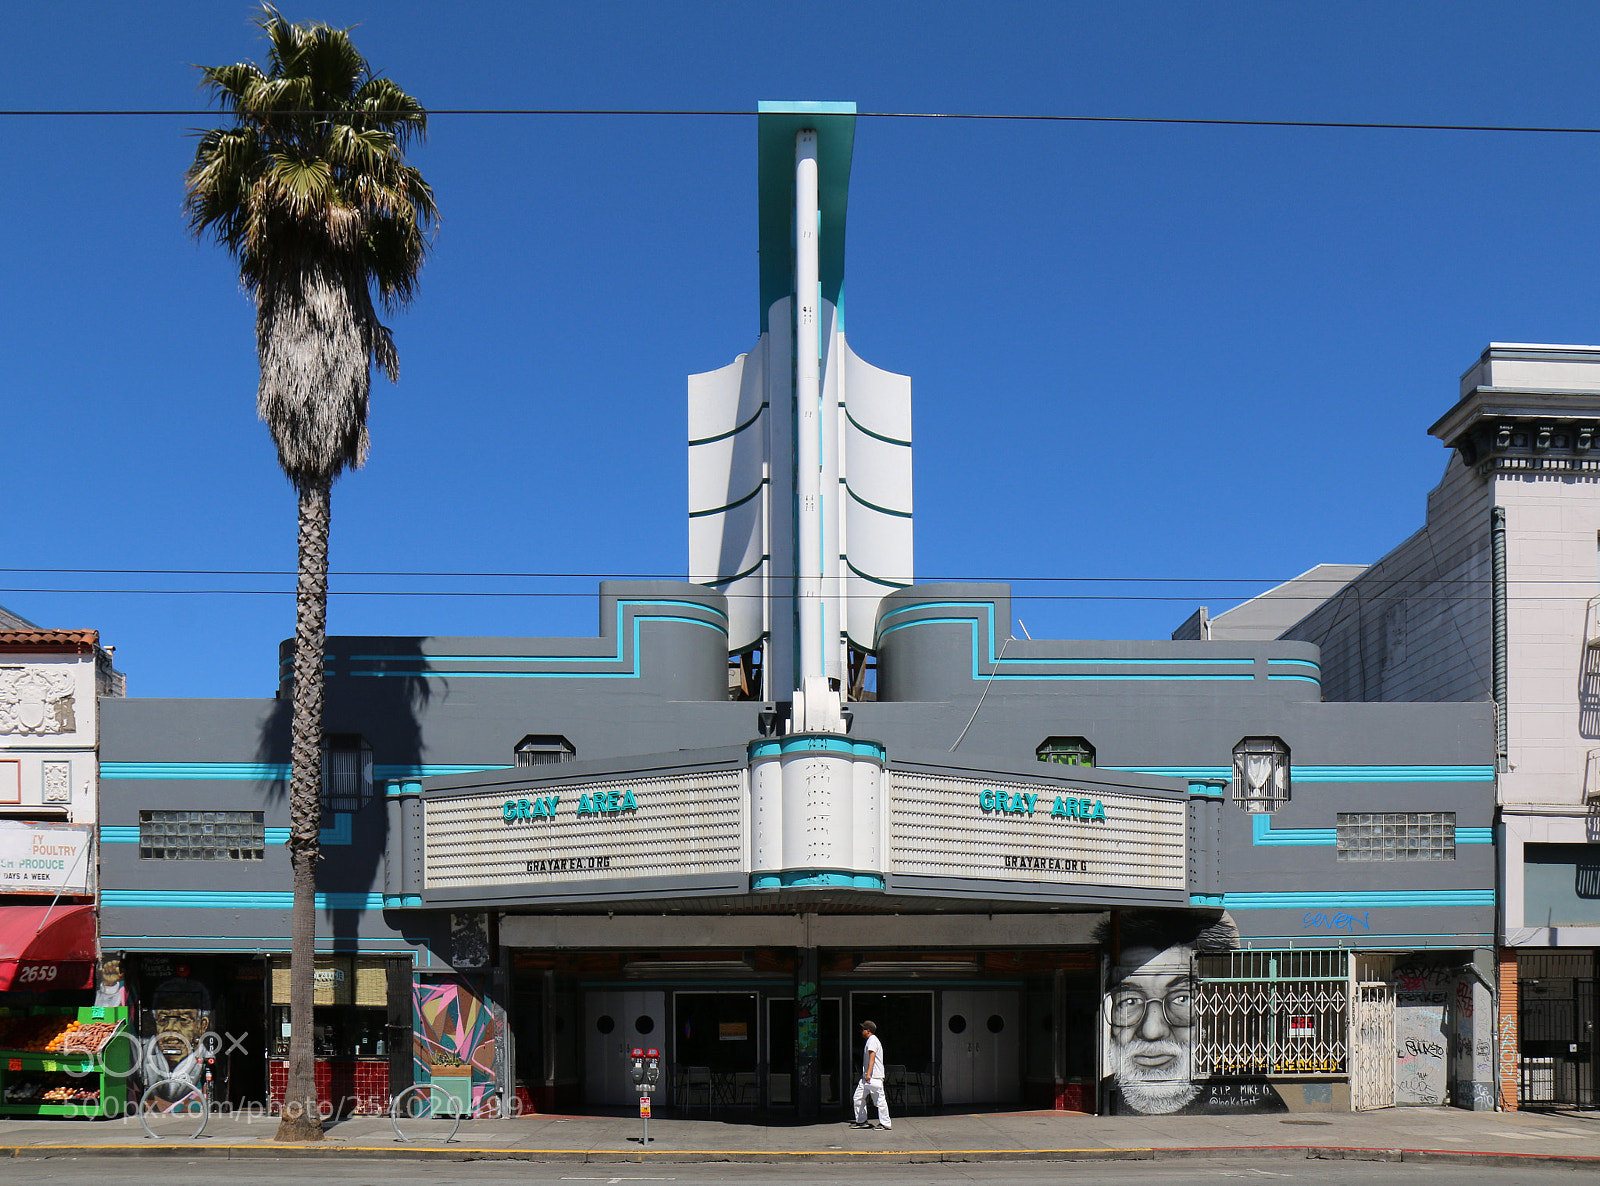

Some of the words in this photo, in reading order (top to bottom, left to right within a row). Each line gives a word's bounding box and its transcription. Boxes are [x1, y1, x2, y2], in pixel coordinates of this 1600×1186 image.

[503, 795, 560, 821] GRAY
[576, 789, 638, 814] AREA
[980, 789, 1039, 814] GRAY
[1051, 796, 1106, 820] AREA
[32, 845, 76, 856] POULTRY
[19, 859, 65, 870] PRODUCE
[526, 857, 610, 872] GRAYAREA.ORG
[1005, 856, 1087, 871] GRAYAREA.ORG
[31, 873, 51, 881] WEEK
[20, 966, 57, 982] 2659
[1240, 1084, 1260, 1095] MIKE
